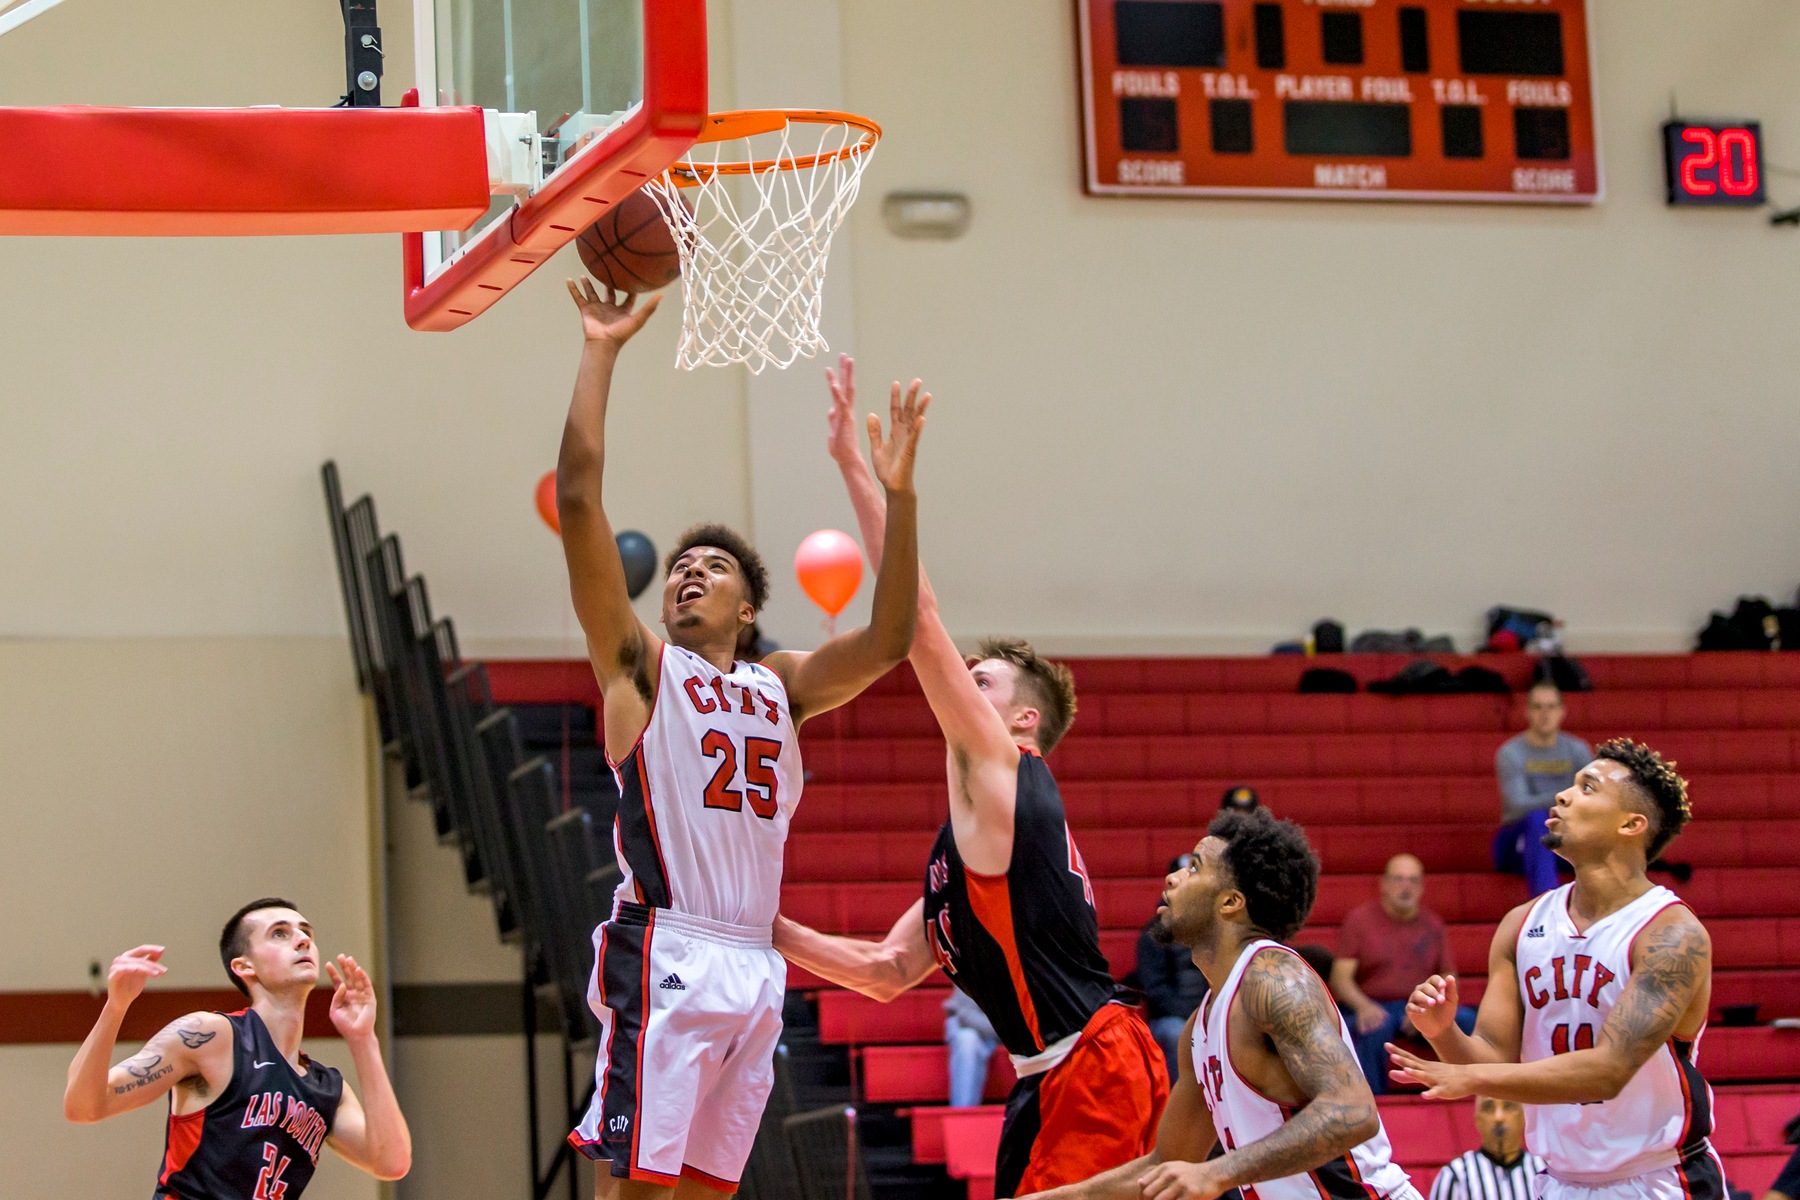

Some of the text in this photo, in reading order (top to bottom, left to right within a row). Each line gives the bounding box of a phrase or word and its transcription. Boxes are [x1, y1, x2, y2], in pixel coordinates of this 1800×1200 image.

[1112, 71, 1180, 98] FOULS
[1274, 74, 1414, 102] PLAYER FOUL
[1507, 79, 1572, 107] FOULS
[1118, 159, 1184, 185] SCORE
[1681, 127, 1758, 196] 20
[1314, 164, 1386, 189] MATCH
[1512, 167, 1576, 192] SCORE
[683, 675, 779, 726] CITY
[701, 728, 782, 820] 25
[1525, 954, 1615, 1009] CITY
[241, 1091, 282, 1128] LAS
[610, 1115, 629, 1133] CITY
[253, 1141, 291, 1200] 24
